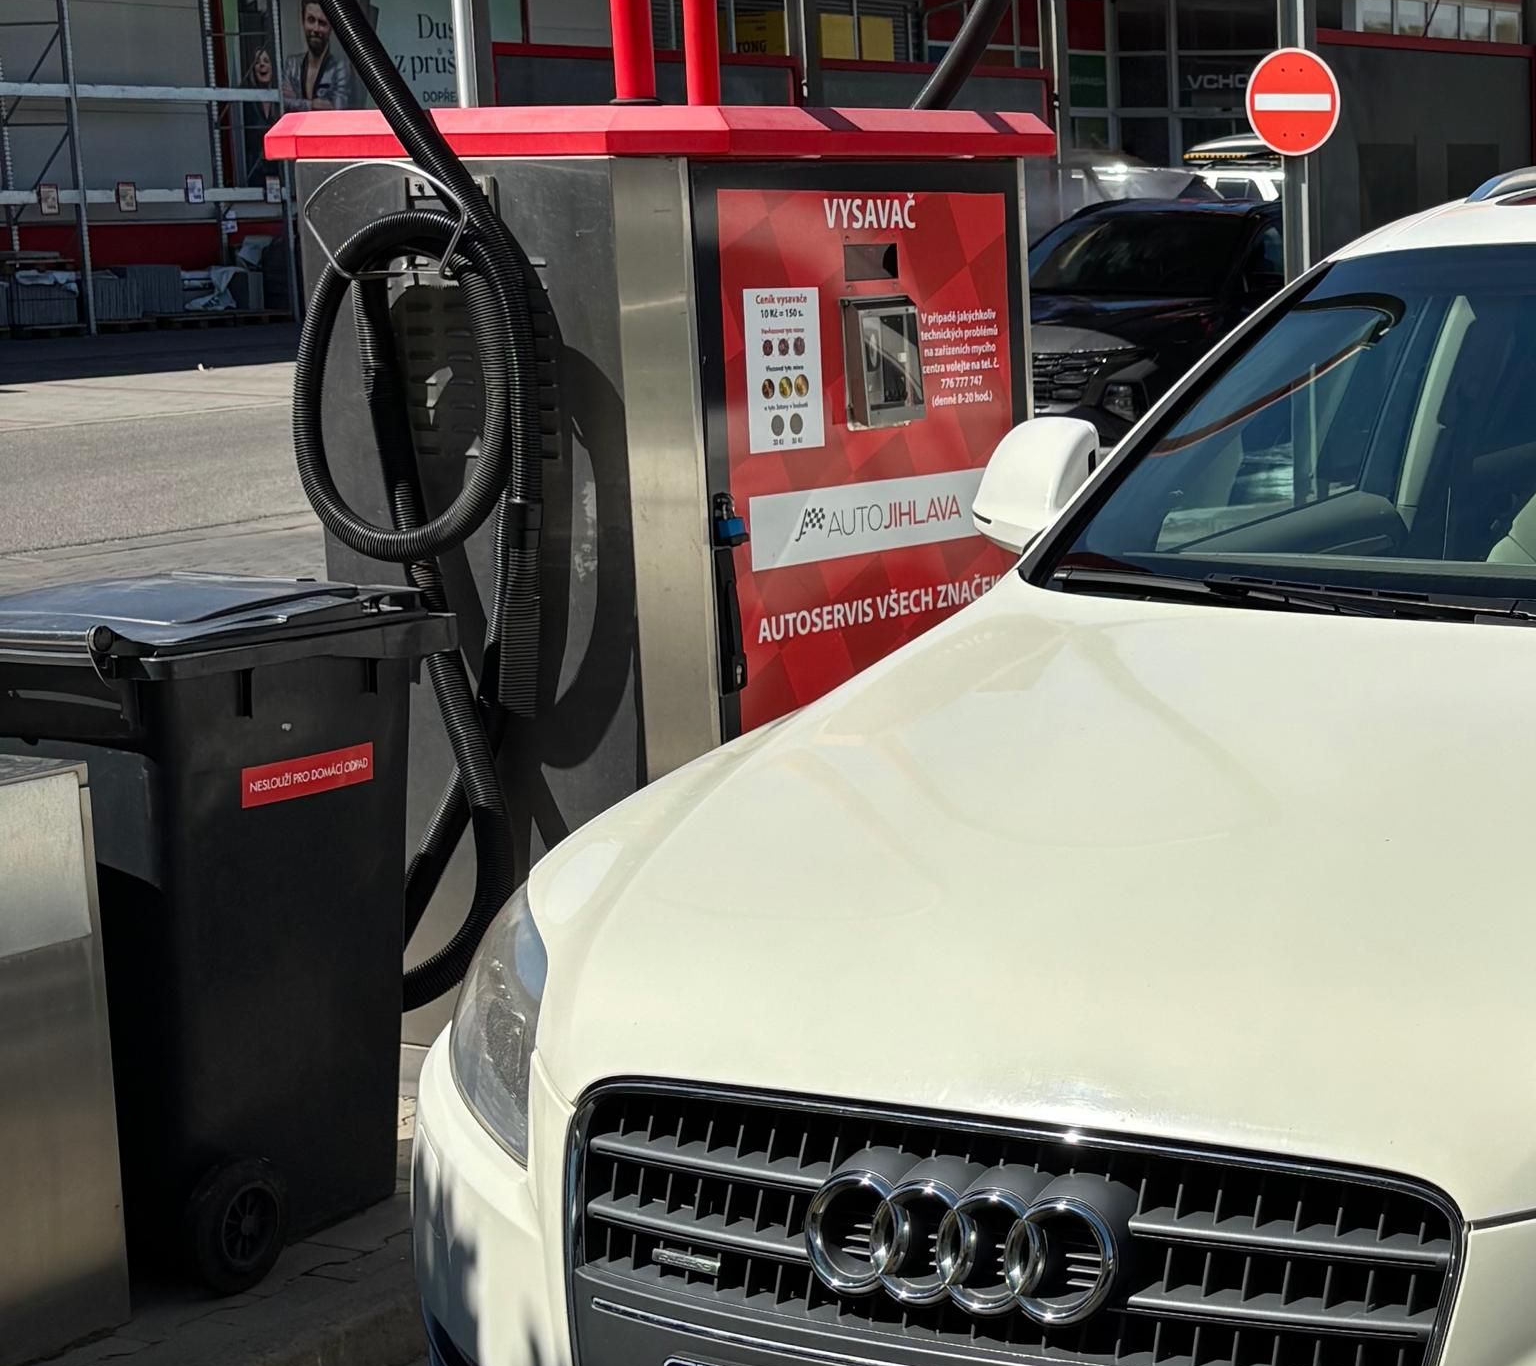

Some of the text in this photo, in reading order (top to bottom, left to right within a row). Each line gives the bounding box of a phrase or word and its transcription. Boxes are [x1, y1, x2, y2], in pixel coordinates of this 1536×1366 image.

[823, 192, 916, 229] VYSAVAČ
[755, 293, 807, 306] Ceník vysavače
[760, 309, 769, 318] 10
[785, 308, 797, 317] 150
[921, 308, 996, 326] V případě jakýchkoliv
[921, 324, 998, 341] technických problémů
[924, 348, 933, 357] na
[922, 363, 945, 374] centra
[946, 360, 970, 373] volejte
[971, 361, 980, 370] na
[940, 377, 955, 389] 776
[955, 376, 969, 388] 777
[932, 393, 957, 408] (denně
[828, 494, 962, 538] AUTOJIHLAVA
[758, 597, 874, 644] AUTOSERVIS
[876, 586, 933, 620] VŠECH
[249, 757, 368, 793] NESLOUŽÍ PRO DOMÁCÍ ODPAD
